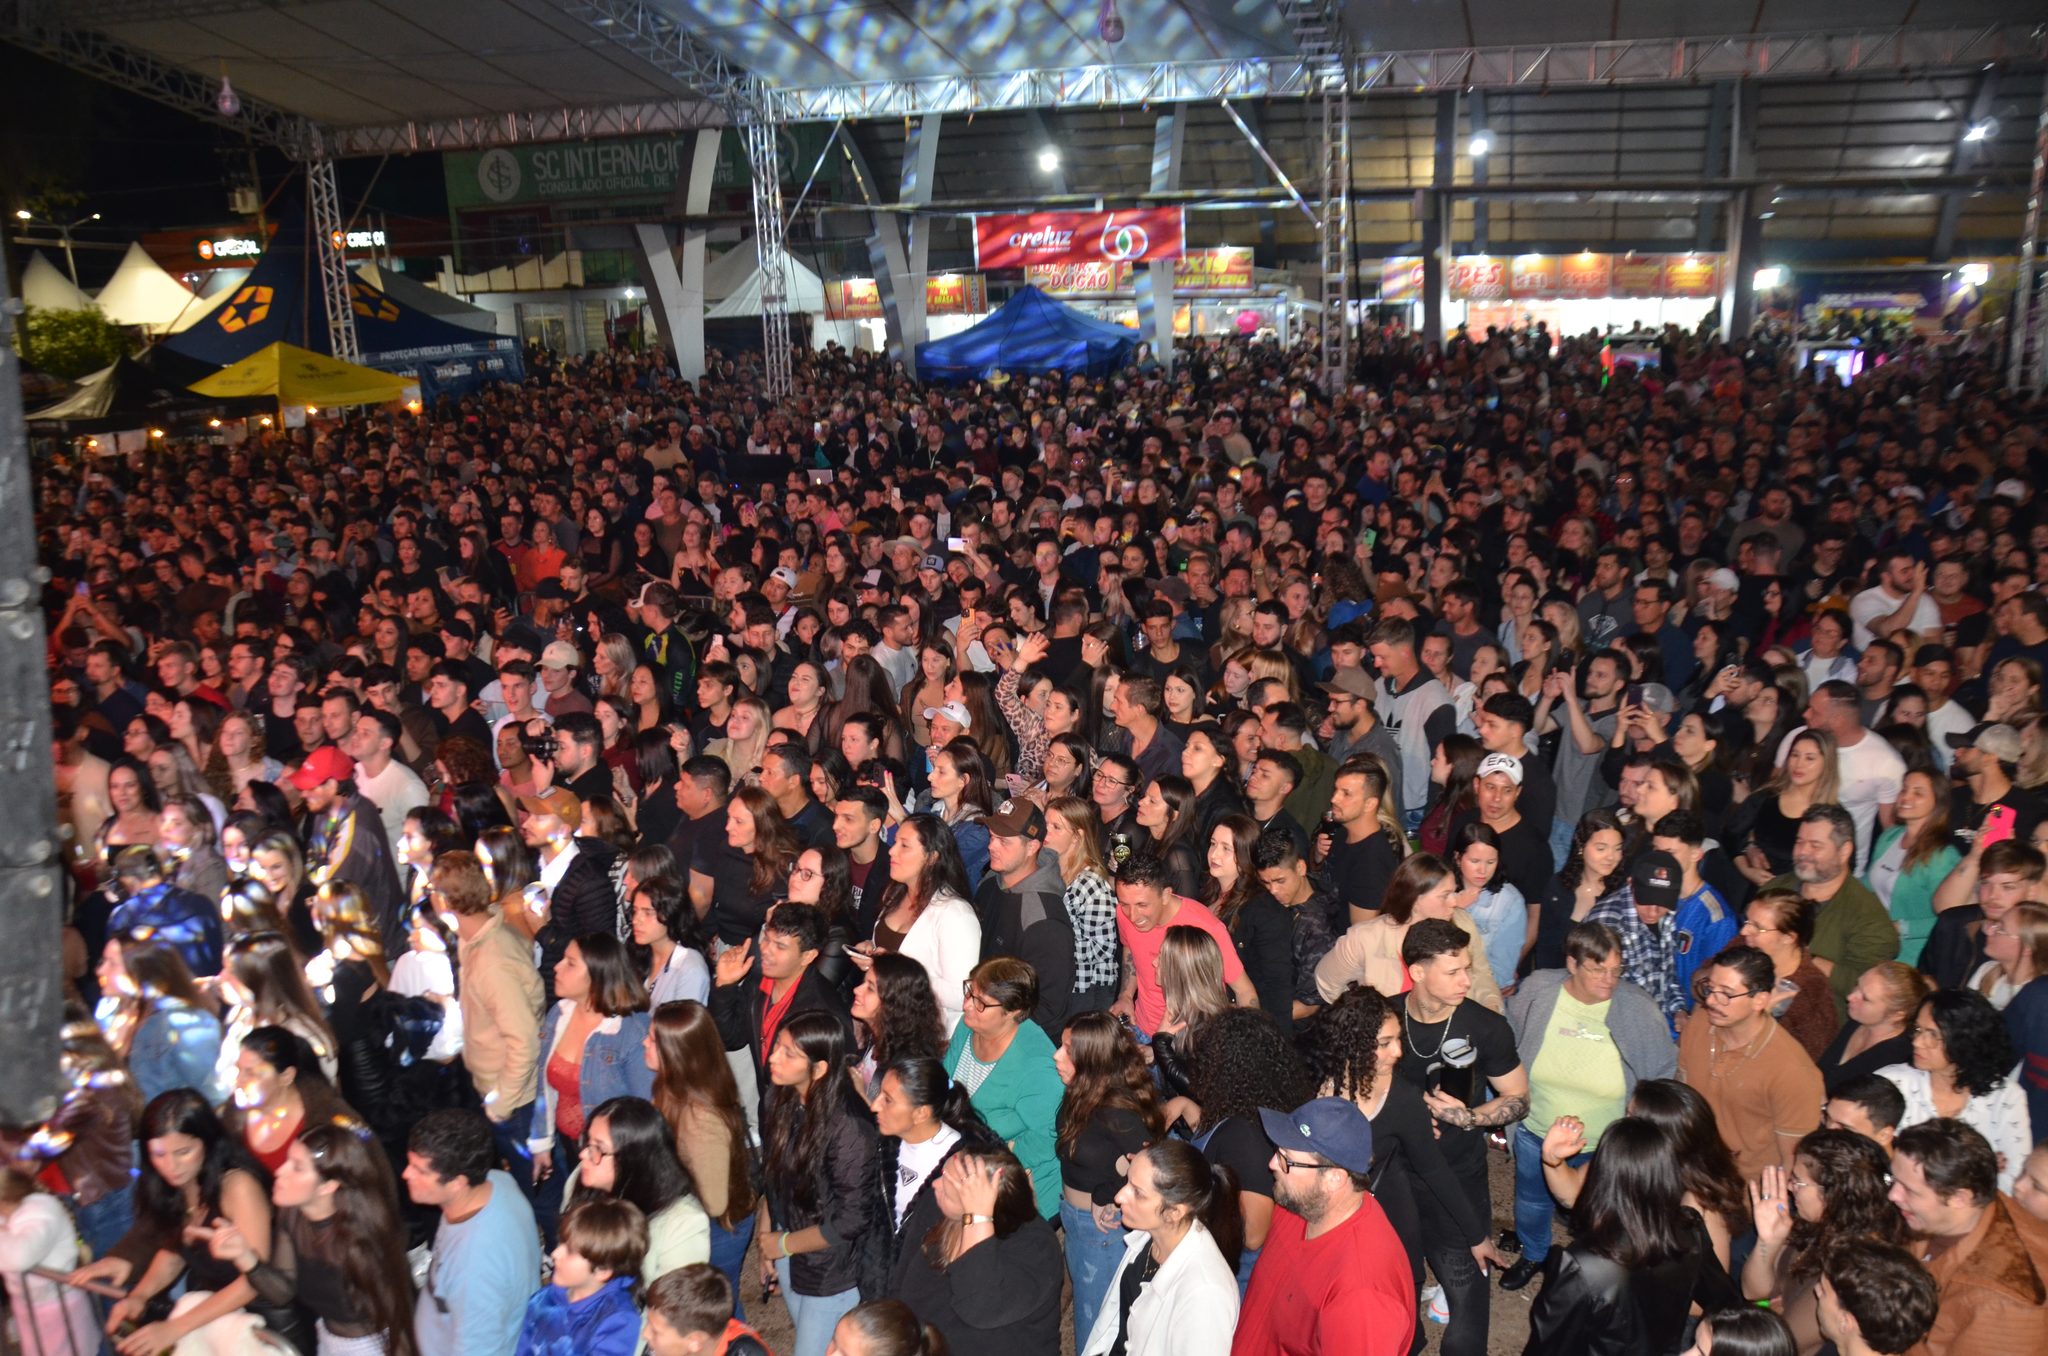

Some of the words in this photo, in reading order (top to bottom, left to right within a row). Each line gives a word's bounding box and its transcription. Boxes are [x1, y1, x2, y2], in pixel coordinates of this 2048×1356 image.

[532, 151, 561, 181] SC
[606, 171, 648, 190] OFICIAL
[653, 172, 670, 188] DE
[1009, 225, 1073, 248] creluz
[419, 344, 453, 357] VEICULAR
[453, 342, 475, 353] TOTAL
[496, 338, 513, 350] STAR
[486, 358, 504, 370] STAR
